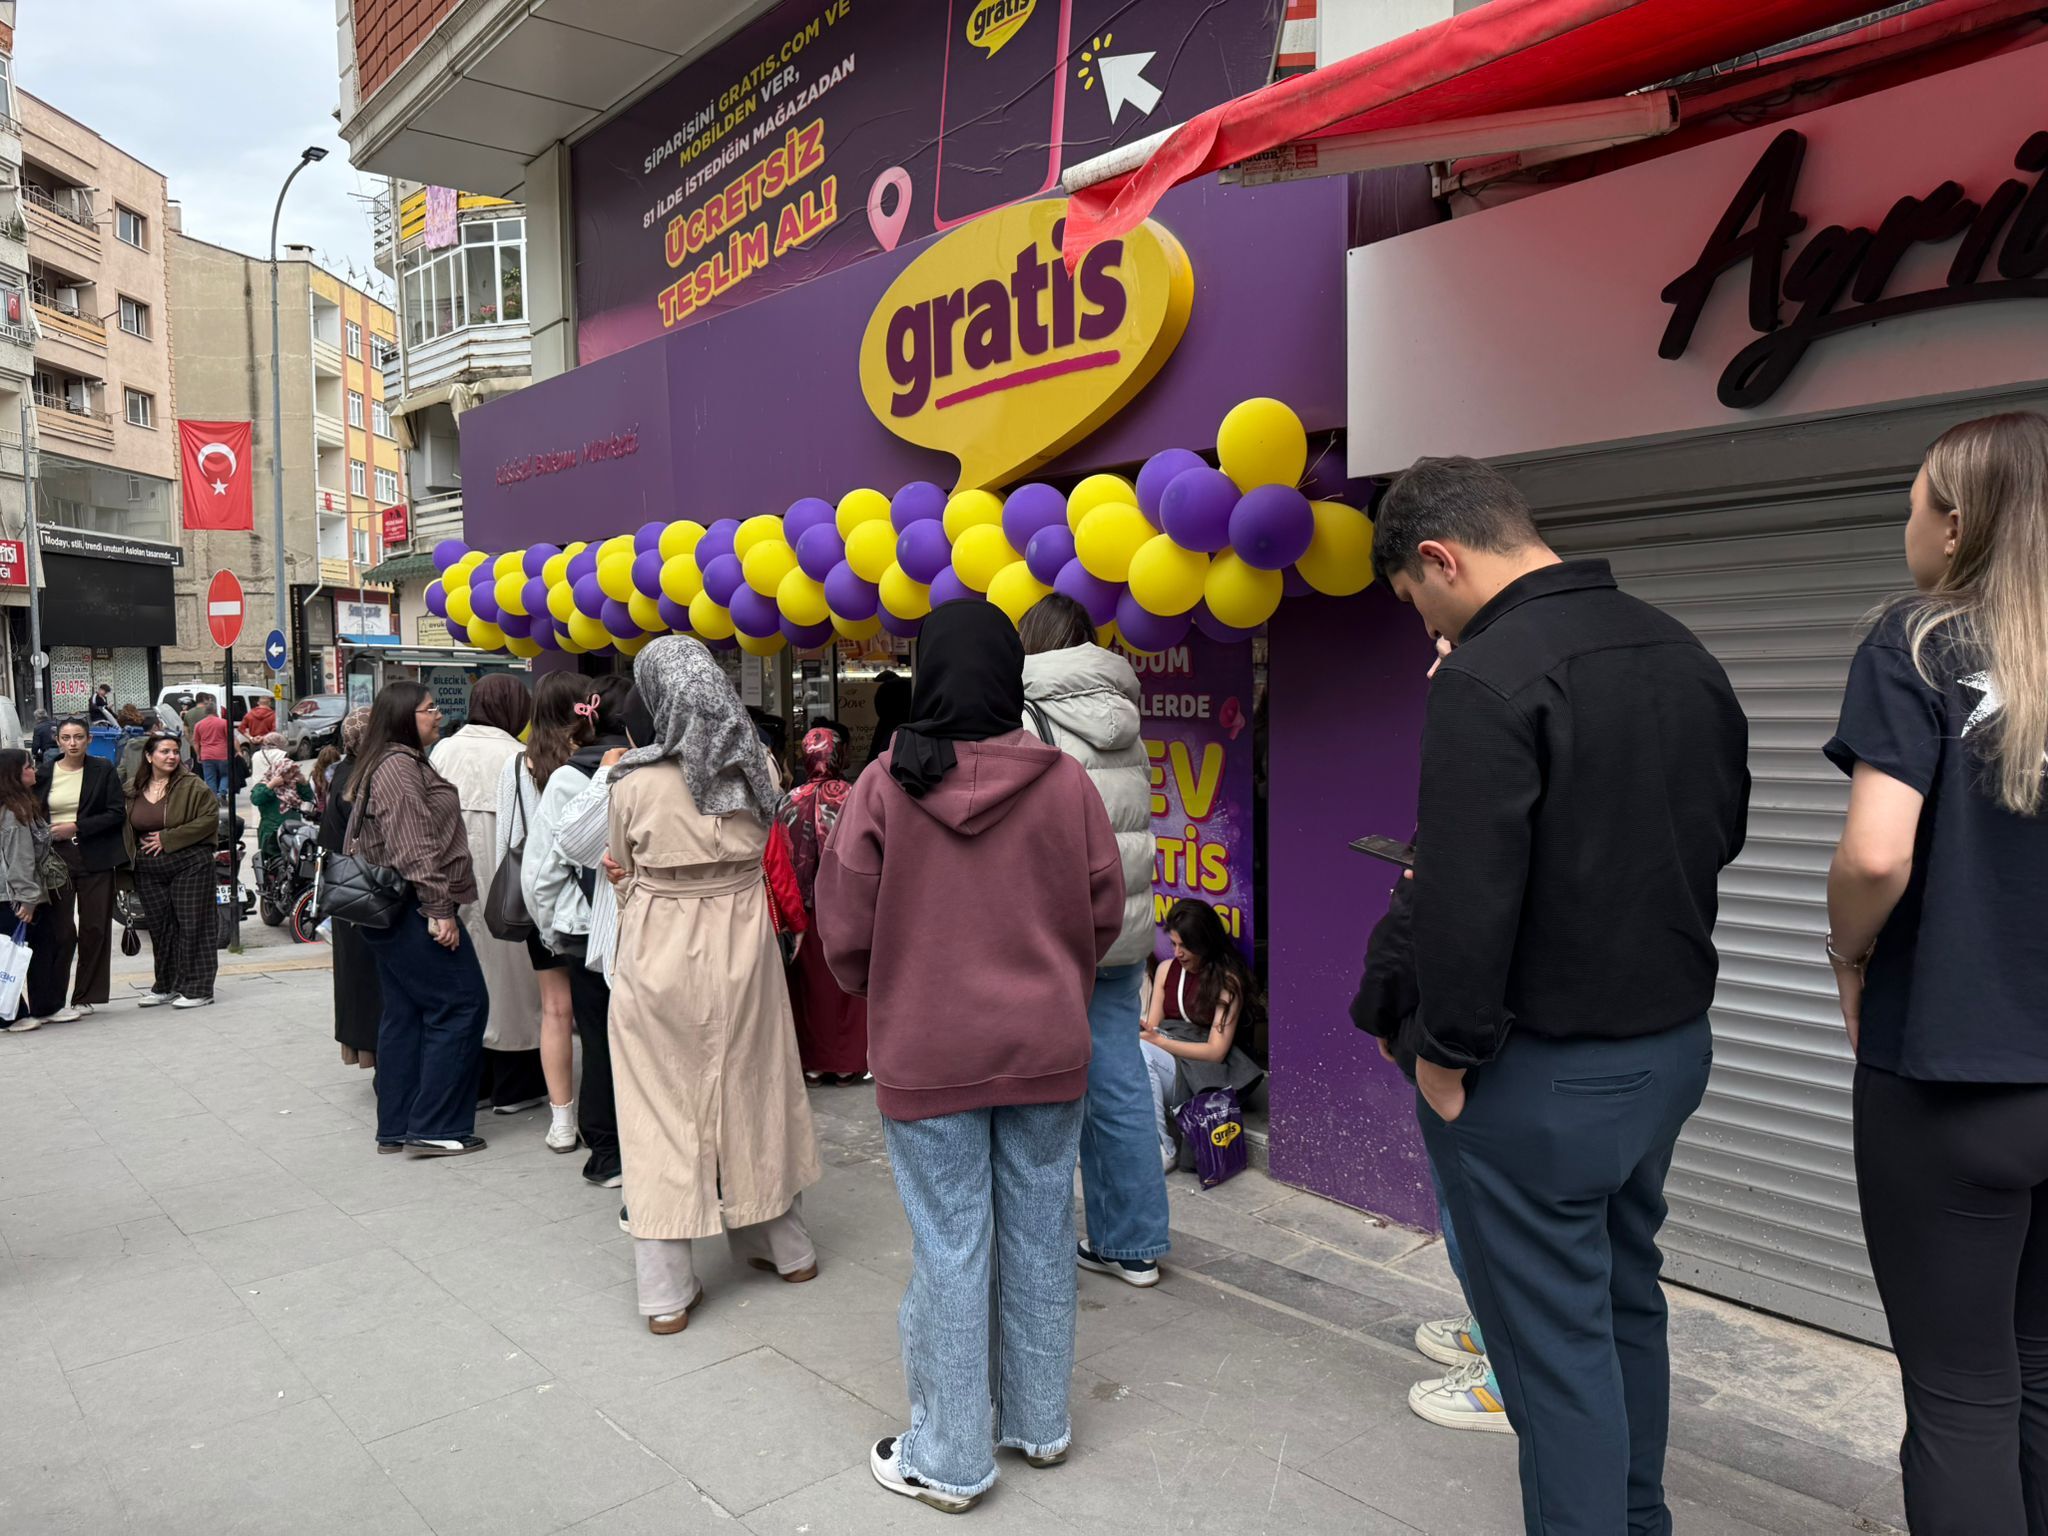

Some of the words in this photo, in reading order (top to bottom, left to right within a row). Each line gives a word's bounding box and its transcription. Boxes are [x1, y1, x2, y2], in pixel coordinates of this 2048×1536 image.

[644, 99, 715, 174] SİPARİŞİNİ
[719, 18, 819, 112] GRATIS.COM
[680, 95, 756, 168] MOBİLDEN
[760, 65, 800, 103] VER,
[643, 211, 655, 228] 81
[657, 191, 683, 220] İLDE
[685, 133, 750, 197] İSTEDİĞİN
[753, 53, 855, 149] MAĞAZADAN
[666, 118, 824, 267] ÜCRETSİZ
[658, 222, 768, 327] TESLİM
[773, 175, 837, 256] AL!
[886, 217, 1127, 417] gratis
[434, 674, 460, 684] BİLECİK
[436, 697, 465, 705] HAKLARI
[438, 687, 462, 696] ÇOCUK
[839, 696, 865, 709] Dove
[1140, 694, 1210, 718] LERDE
[1154, 824, 1230, 893] TİS
